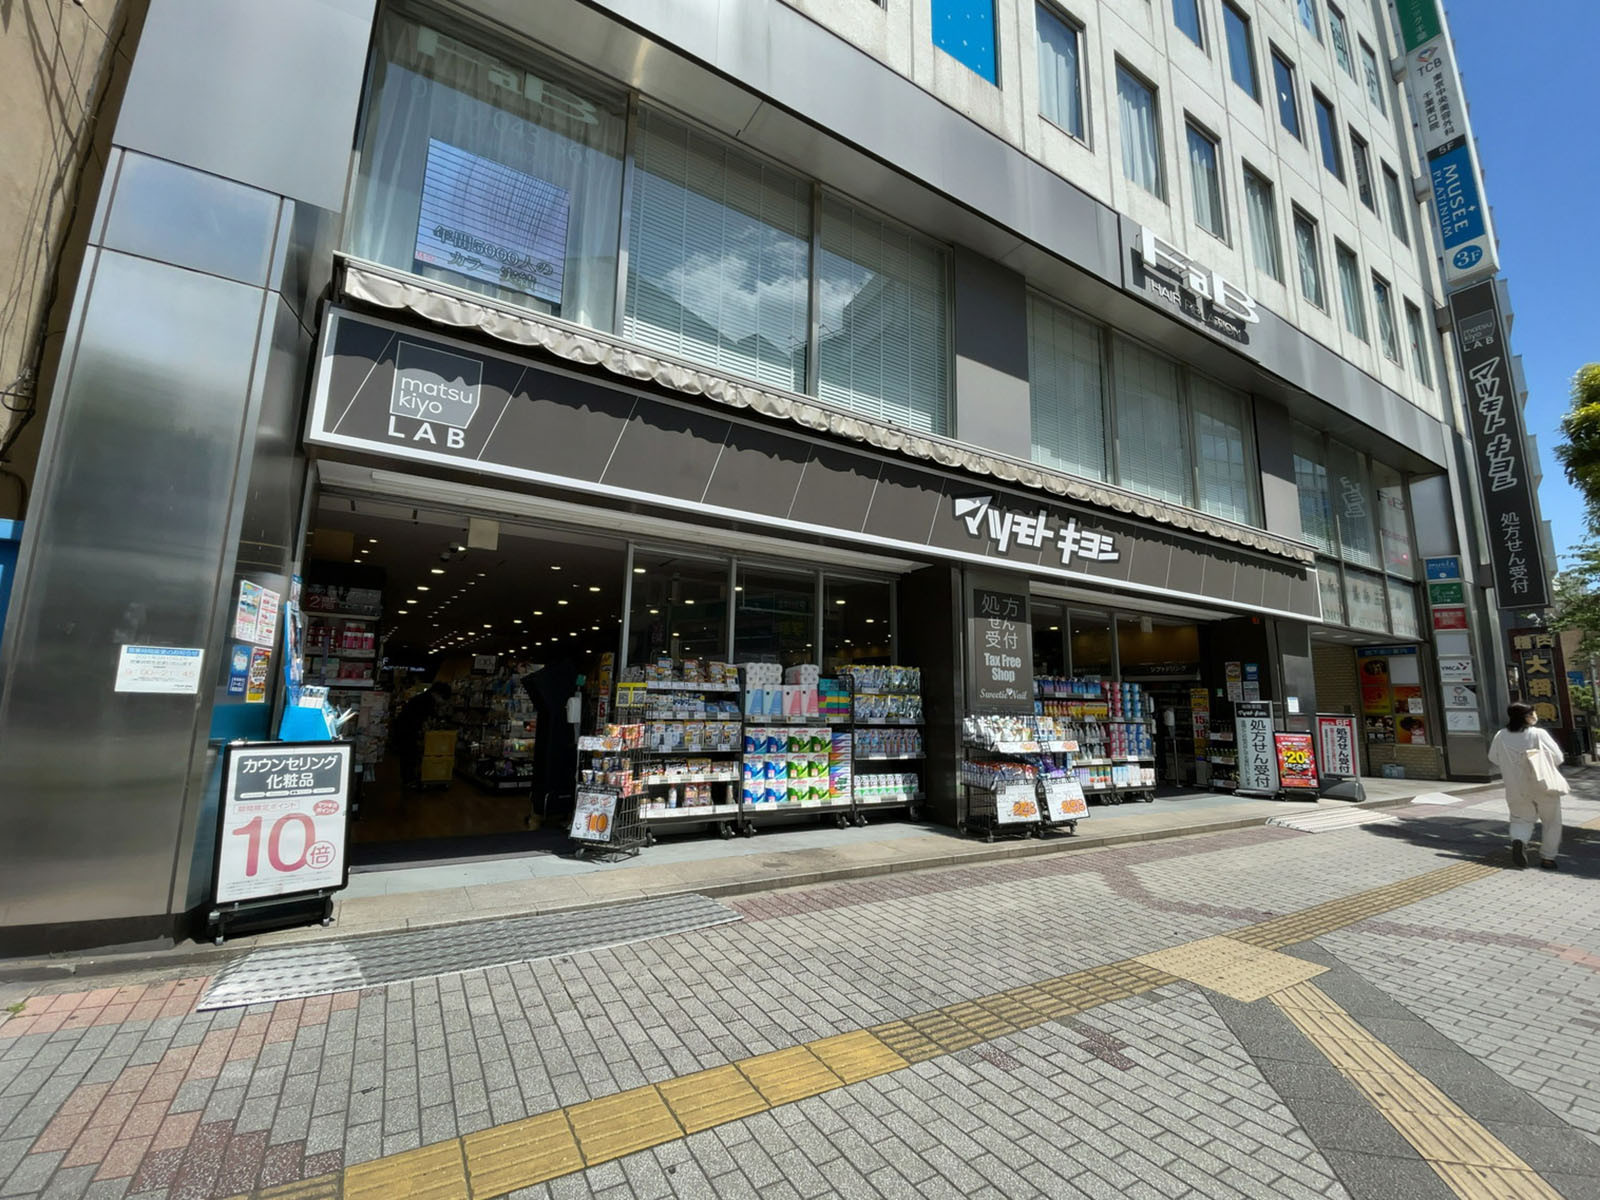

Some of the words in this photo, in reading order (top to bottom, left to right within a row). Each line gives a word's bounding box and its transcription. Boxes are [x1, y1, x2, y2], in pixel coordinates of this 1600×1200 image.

[1417, 57, 1442, 76] TCB
[1433, 170, 1453, 238] PLATINUM
[1456, 250, 1481, 267] 3F
[1141, 225, 1260, 324] FaB
[1151, 279, 1182, 307] HAIR
[1463, 336, 1494, 352] LAB
[401, 377, 473, 404] matsu
[399, 390, 442, 419] kiyo
[387, 415, 465, 449] LAB
[1501, 512, 1530, 595] 処方せん受付
[981, 593, 1019, 617] 処方
[988, 616, 1015, 630] せん
[985, 631, 1018, 649] 受付
[984, 653, 1000, 667] Tax
[1002, 654, 1022, 668] Free
[992, 667, 1015, 683] Shop
[242, 755, 338, 773] カウンセリング
[1250, 719, 1271, 788] 処方せん受付
[1287, 751, 1305, 764] 20
[266, 772, 314, 789] 化粧品
[232, 813, 316, 877] 10
[310, 845, 331, 865] 倍
